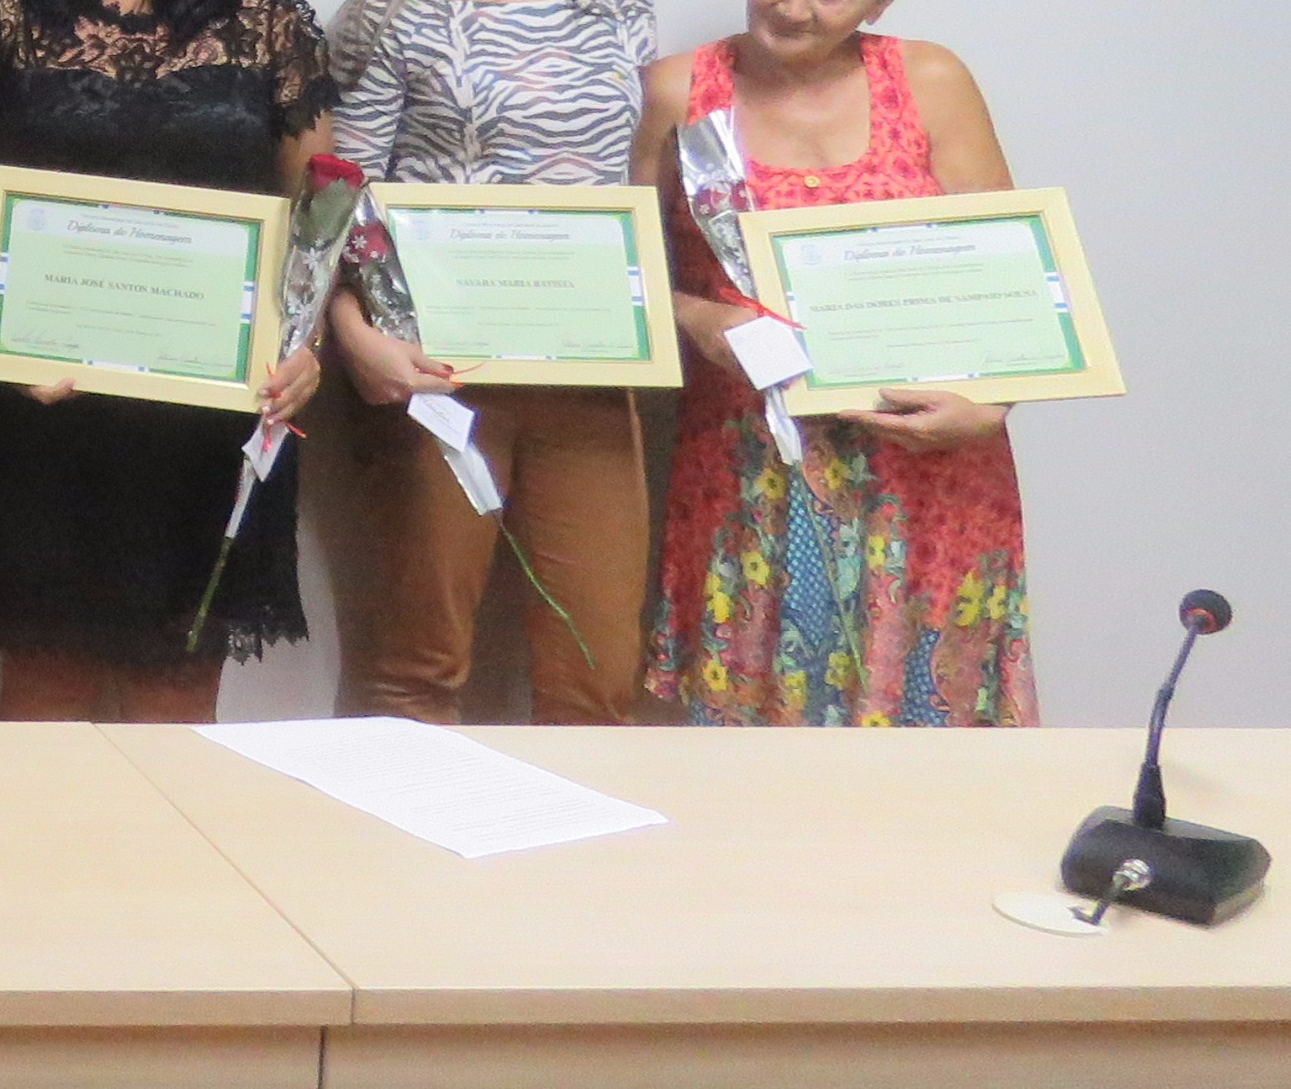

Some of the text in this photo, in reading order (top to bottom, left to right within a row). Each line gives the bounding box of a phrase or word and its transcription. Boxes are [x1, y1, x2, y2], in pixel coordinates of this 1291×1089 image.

[67, 219, 111, 233] Diploma
[113, 226, 127, 237] de
[44, 273, 205, 300] MARIA JOSÉ SANTOS MACHADO
